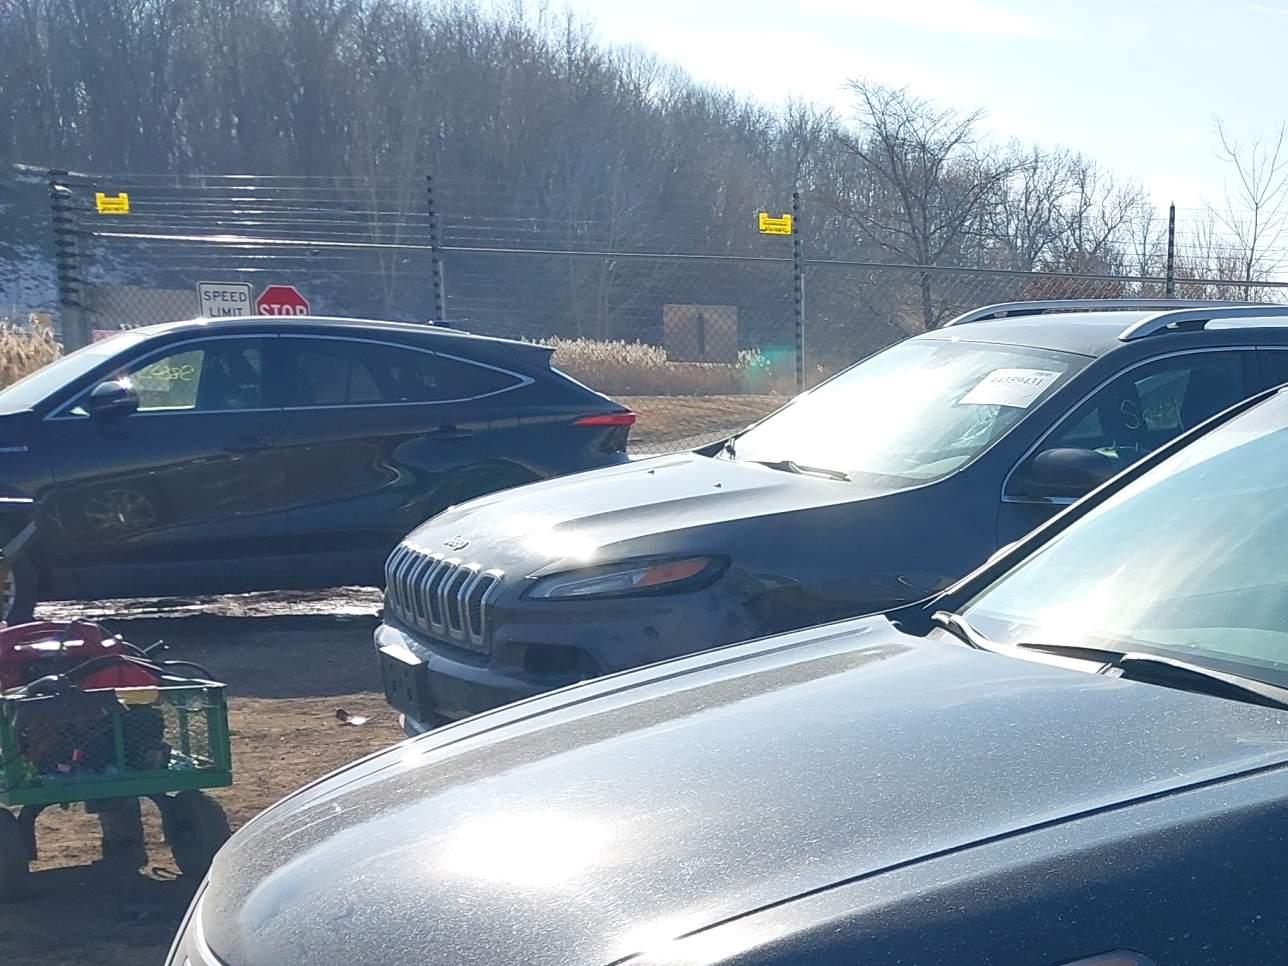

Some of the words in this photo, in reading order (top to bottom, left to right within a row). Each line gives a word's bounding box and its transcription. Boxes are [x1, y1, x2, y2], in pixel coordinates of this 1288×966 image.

[203, 291, 247, 302] SPEED
[209, 307, 243, 318] LIMIT
[259, 303, 308, 317] STOP
